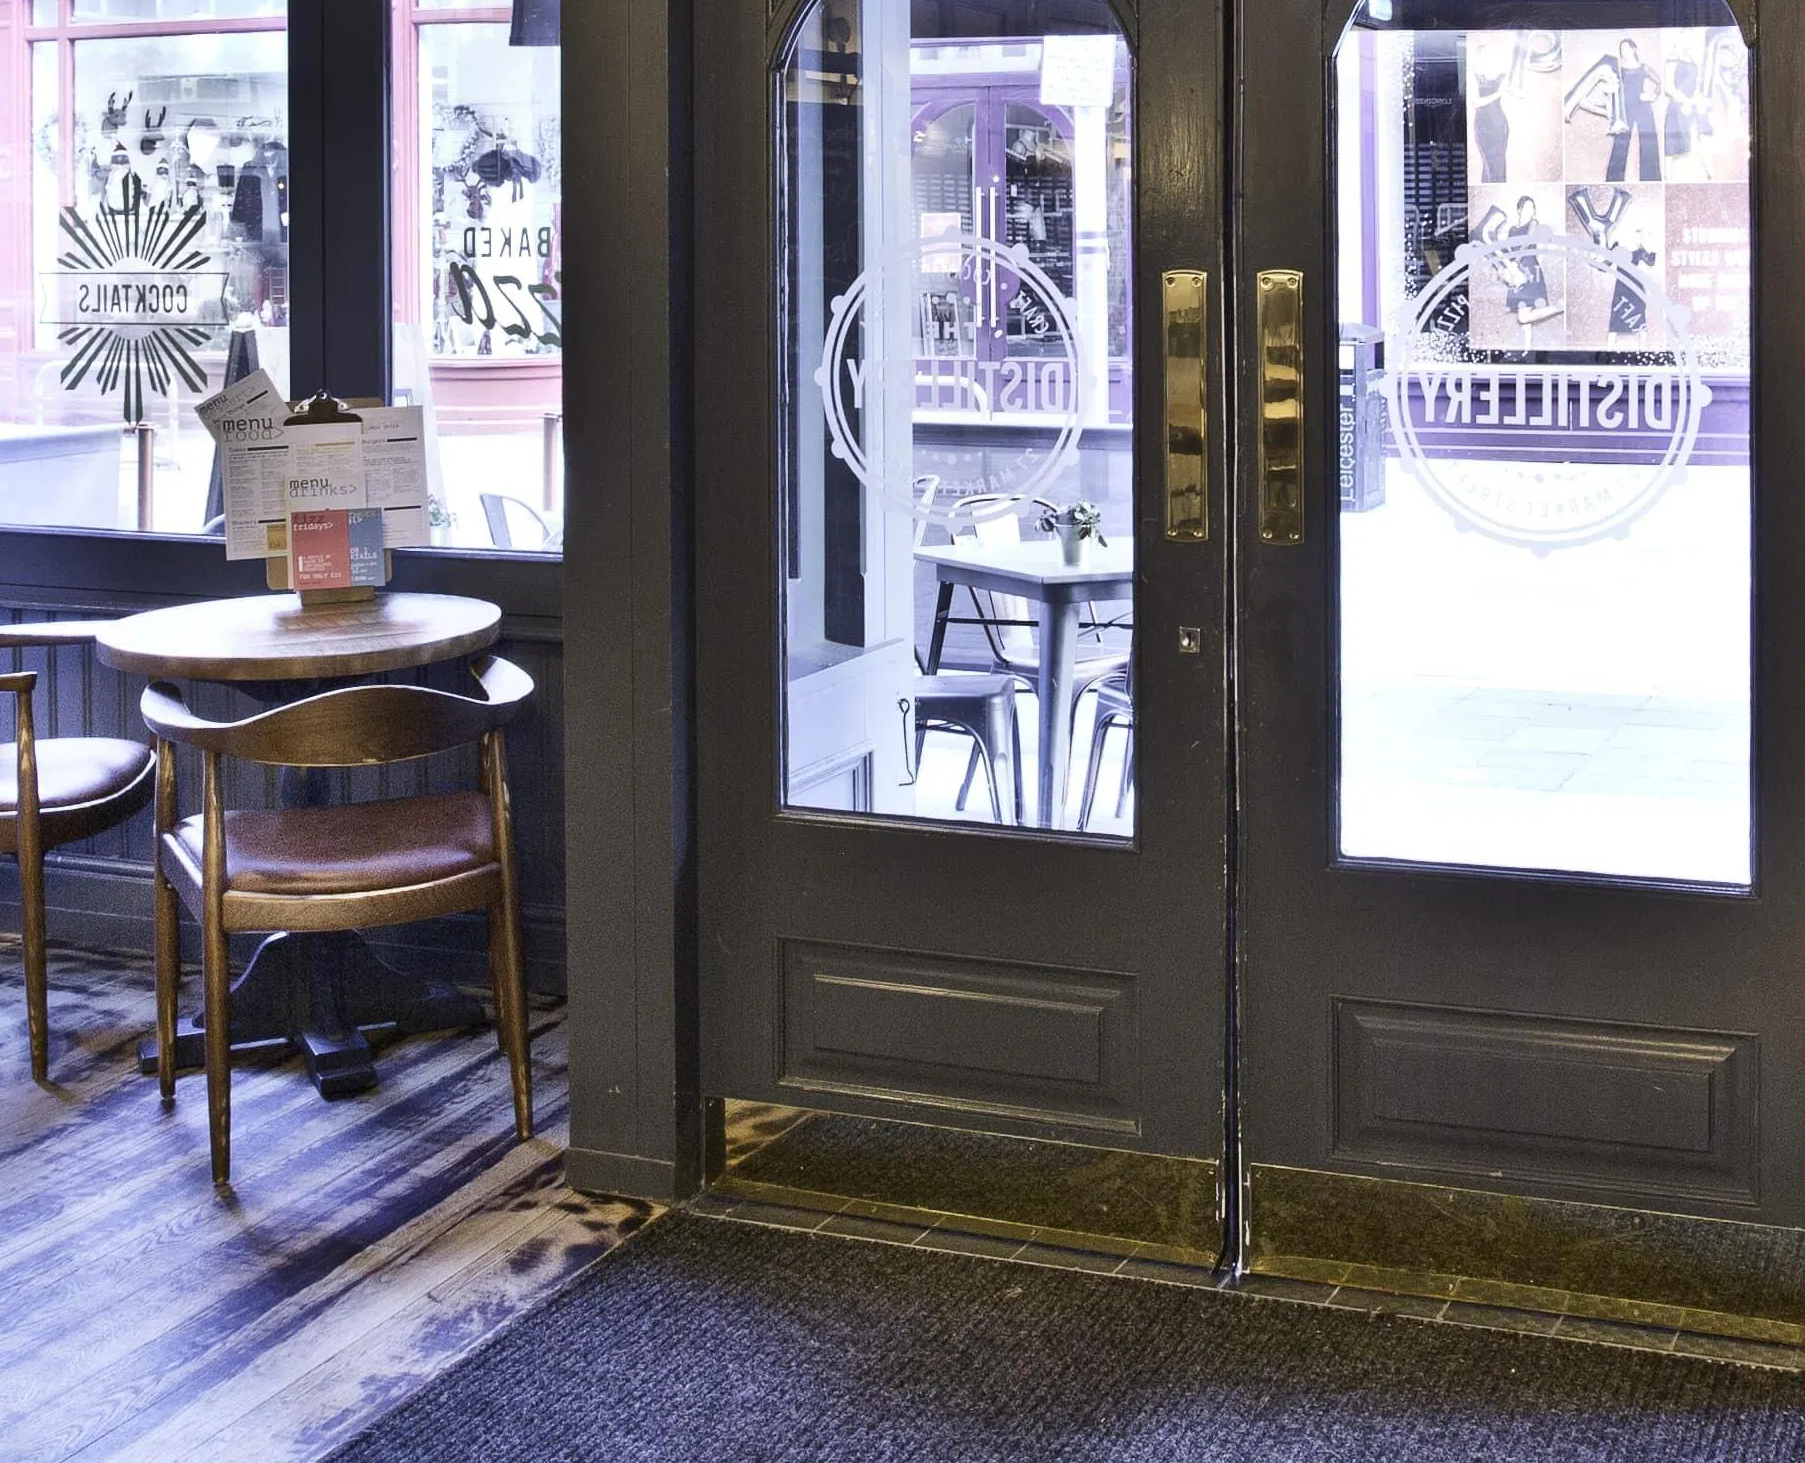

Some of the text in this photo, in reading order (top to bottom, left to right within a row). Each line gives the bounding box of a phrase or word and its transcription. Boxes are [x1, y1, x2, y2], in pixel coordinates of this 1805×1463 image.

[199, 395, 228, 415] menu
[223, 417, 273, 431] menu
[289, 477, 329, 488] menu
